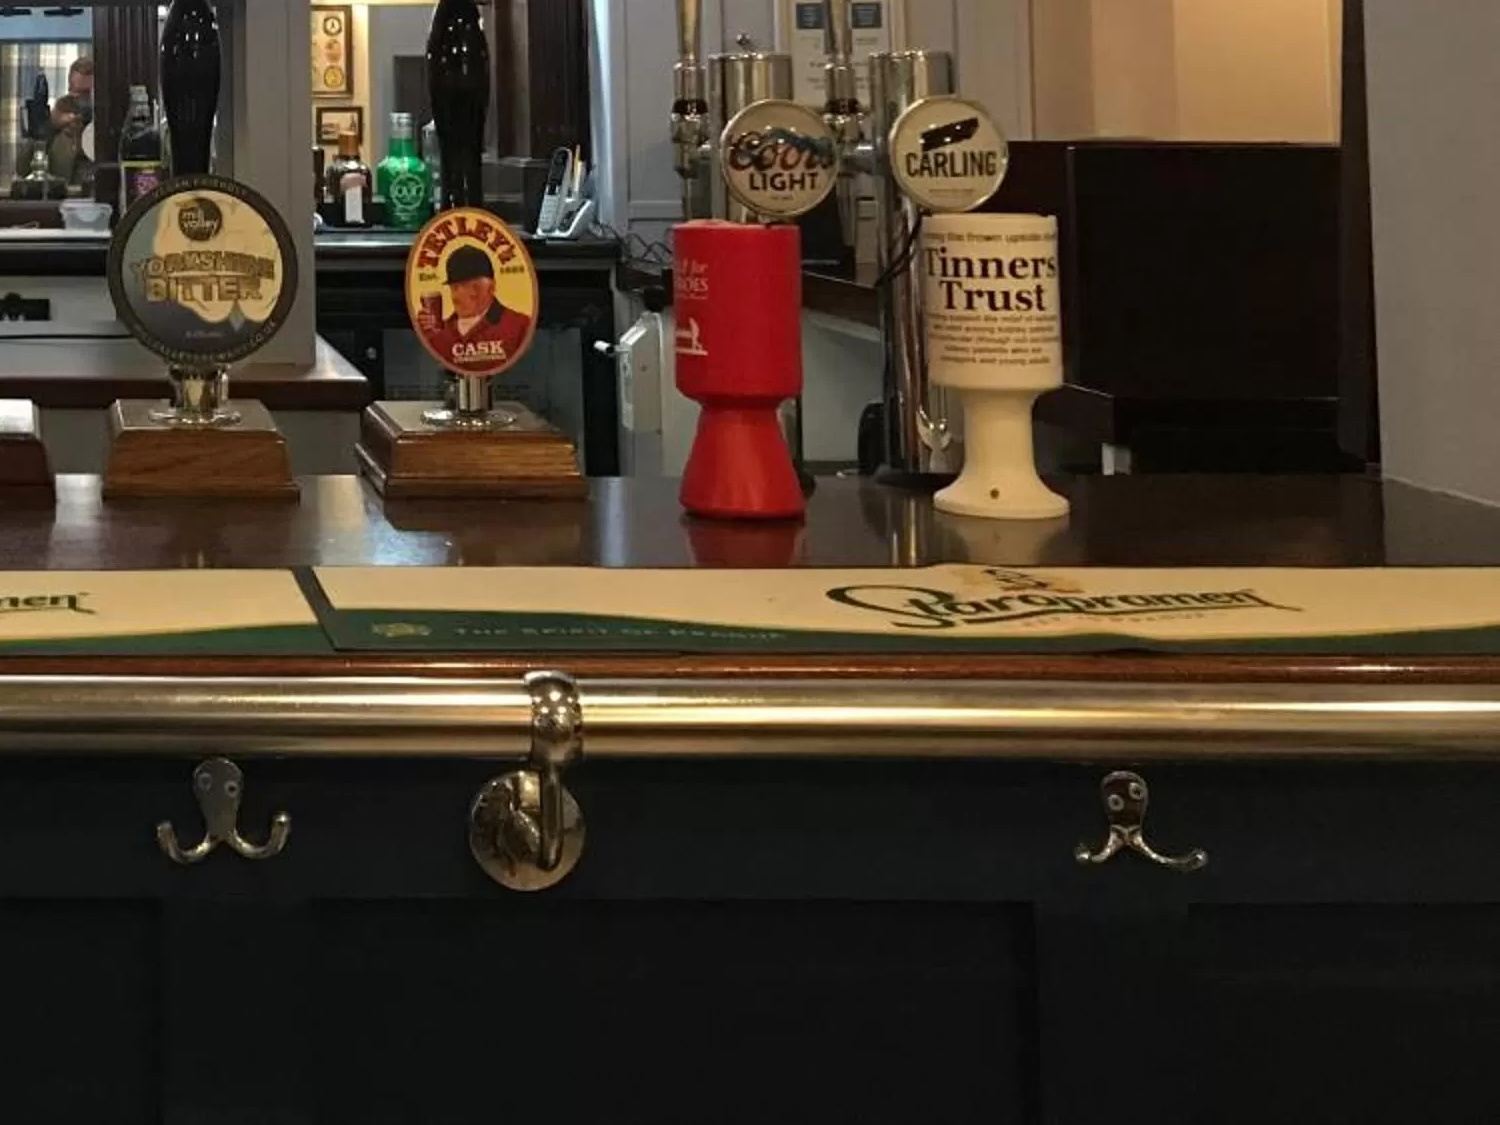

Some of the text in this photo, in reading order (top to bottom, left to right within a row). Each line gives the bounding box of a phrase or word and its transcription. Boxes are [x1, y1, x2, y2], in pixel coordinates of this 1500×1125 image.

[729, 130, 835, 171] Coors
[905, 150, 997, 178] CARLING
[749, 172, 819, 191] LIGHT
[417, 216, 517, 268] TETLEY'S
[925, 246, 1057, 279] Tinners
[146, 275, 263, 302] BITTER
[938, 280, 1046, 312] Trust
[451, 340, 504, 357] CASK
[827, 584, 1306, 630] Staropramen
